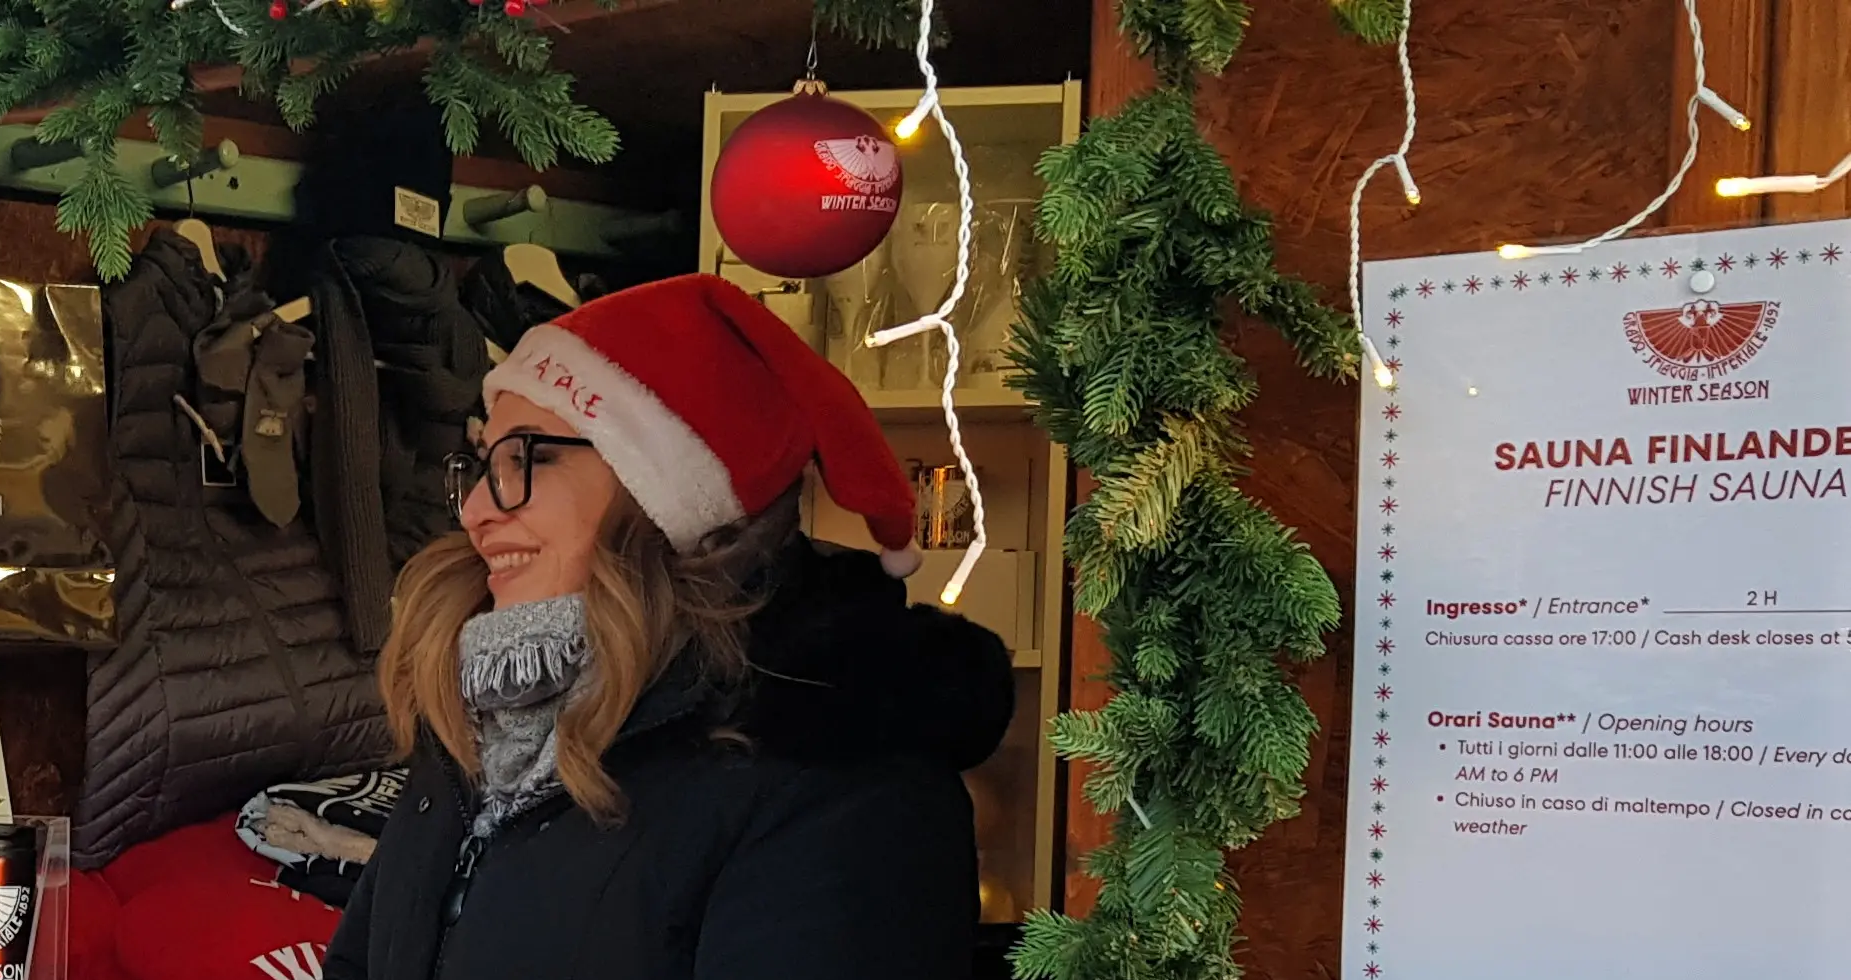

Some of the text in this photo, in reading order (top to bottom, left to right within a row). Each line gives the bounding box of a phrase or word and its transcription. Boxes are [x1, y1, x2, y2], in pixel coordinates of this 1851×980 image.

[821, 195, 867, 211] WINTER
[1627, 380, 1770, 405] WINTER SEASON
[1494, 438, 1633, 470] SAUNA
[1544, 469, 1847, 507] FINNISH SAUNA
[1532, 597, 1543, 619] /
[1746, 590, 1778, 606] 2 H
[1424, 629, 1841, 649] Chiusura cassa ore 17:00 / Cash desk closes at
[1427, 710, 1482, 728] Orari
[1581, 712, 1592, 735] /
[1597, 713, 1688, 736] Opening
[1693, 714, 1754, 733] hours
[1457, 739, 1494, 755] Tutti
[1498, 740, 1503, 756] i
[1507, 741, 1558, 760] giorni
[1563, 741, 1609, 758] dalle
[1613, 743, 1658, 760] 11:00
[1663, 743, 1698, 761] alle
[1702, 745, 1754, 762] 18:00
[1758, 745, 1768, 766] /
[1773, 746, 1828, 768] Every
[1454, 766, 1559, 783] AM to 6 PM
[1455, 791, 1516, 809] Chiuso
[1521, 794, 1536, 809] in
[1541, 798, 1586, 811] caso
[1591, 796, 1609, 812] di
[1614, 798, 1711, 818] maltempo
[1715, 799, 1725, 820] /
[1730, 800, 1802, 819] Closed
[1806, 803, 1824, 820] in
[1454, 819, 1528, 835] weather
